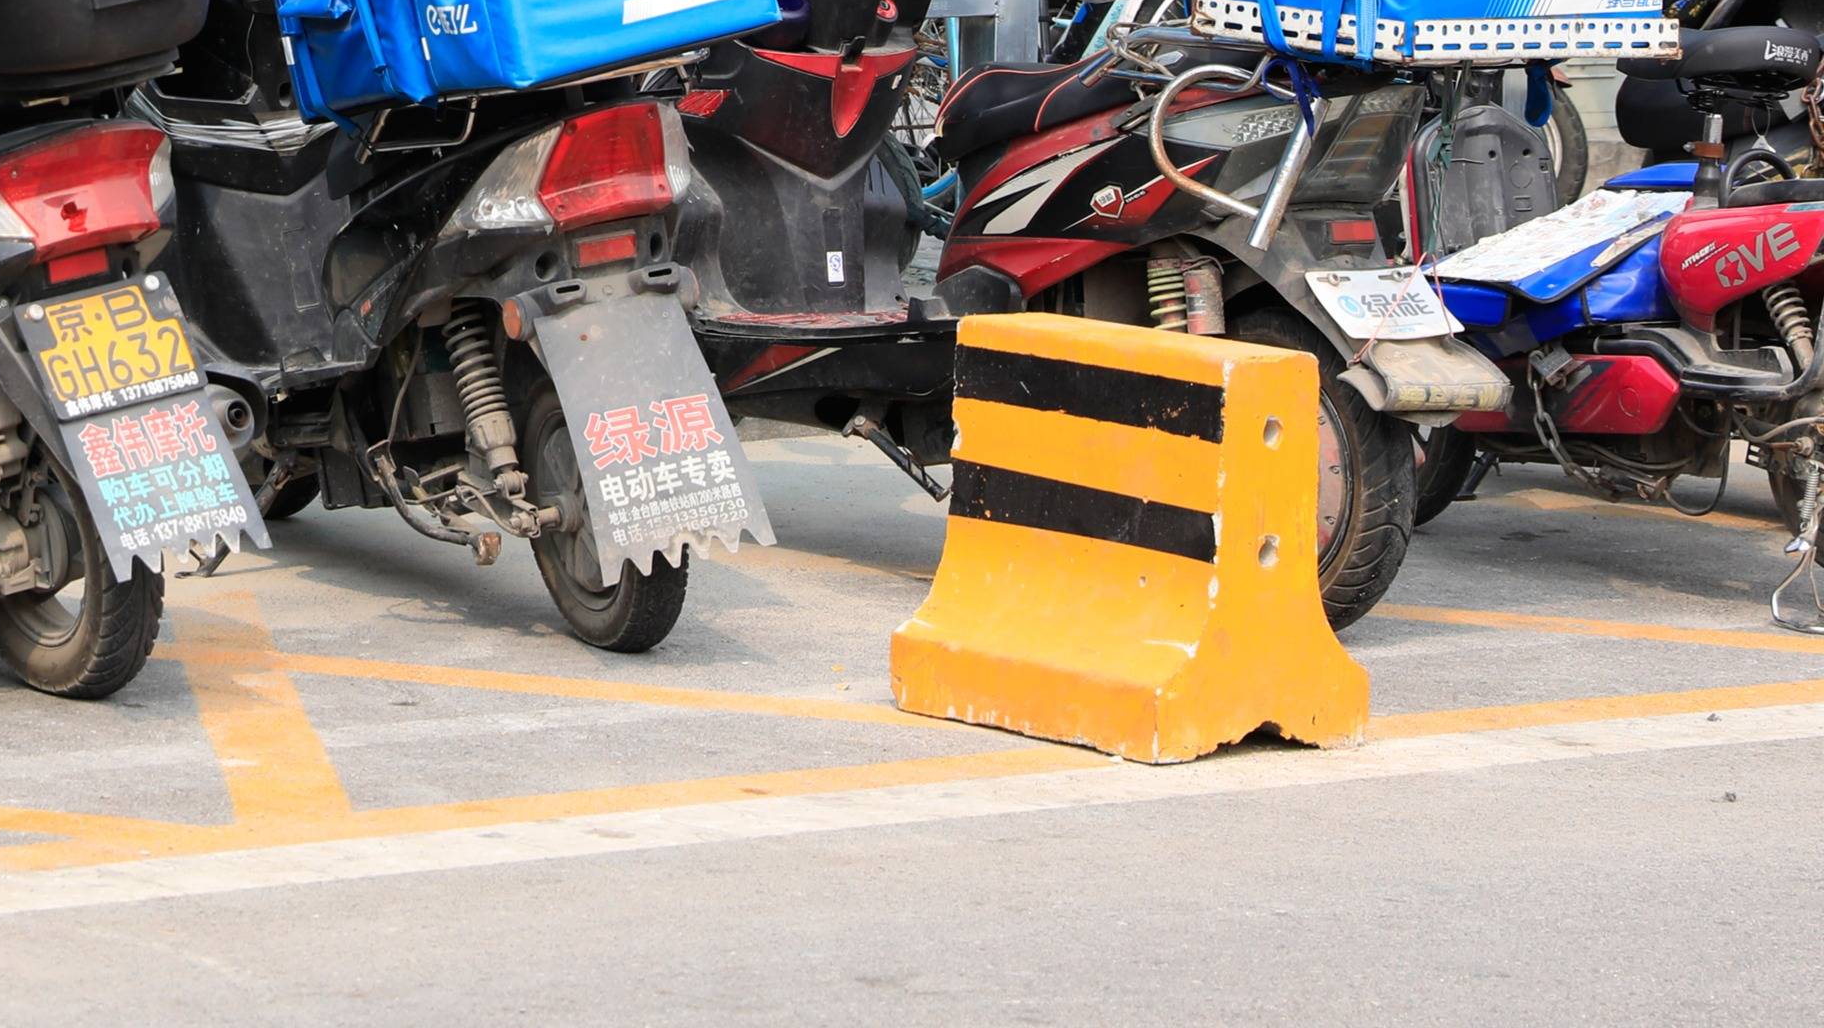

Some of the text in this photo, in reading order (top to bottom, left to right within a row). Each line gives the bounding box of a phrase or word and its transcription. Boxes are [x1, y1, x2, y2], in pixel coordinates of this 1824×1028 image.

[48, 326, 190, 399] GH632
[78, 400, 217, 478] 鑫伟摩托
[584, 393, 725, 470] 绿源
[97, 453, 232, 507] 购车可分期
[113, 482, 239, 531] 代办上牌验车
[599, 450, 738, 508] 电动车专卖
